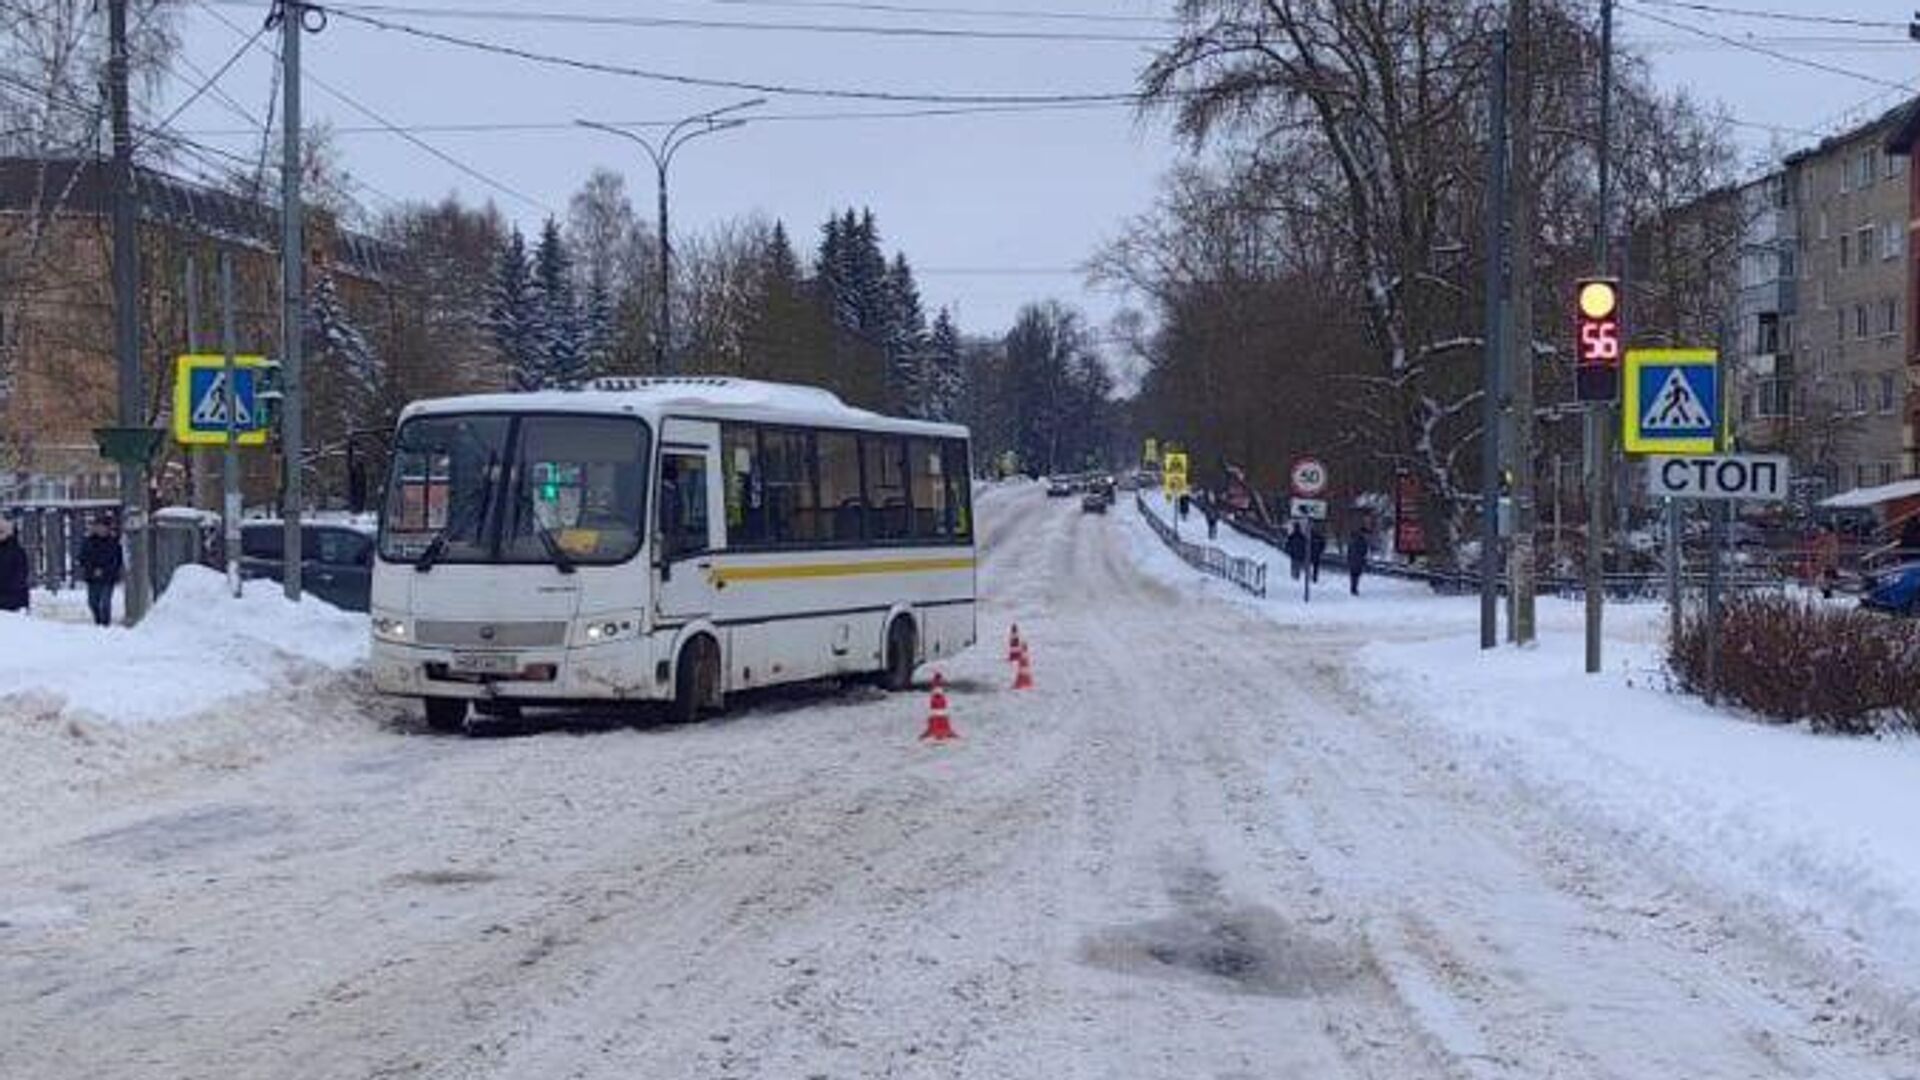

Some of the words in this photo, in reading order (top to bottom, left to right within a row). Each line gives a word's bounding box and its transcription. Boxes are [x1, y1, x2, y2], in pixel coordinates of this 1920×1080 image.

[1582, 322, 1617, 358] 56
[1300, 469, 1320, 484] 50
[1661, 459, 1777, 493] СТОП
